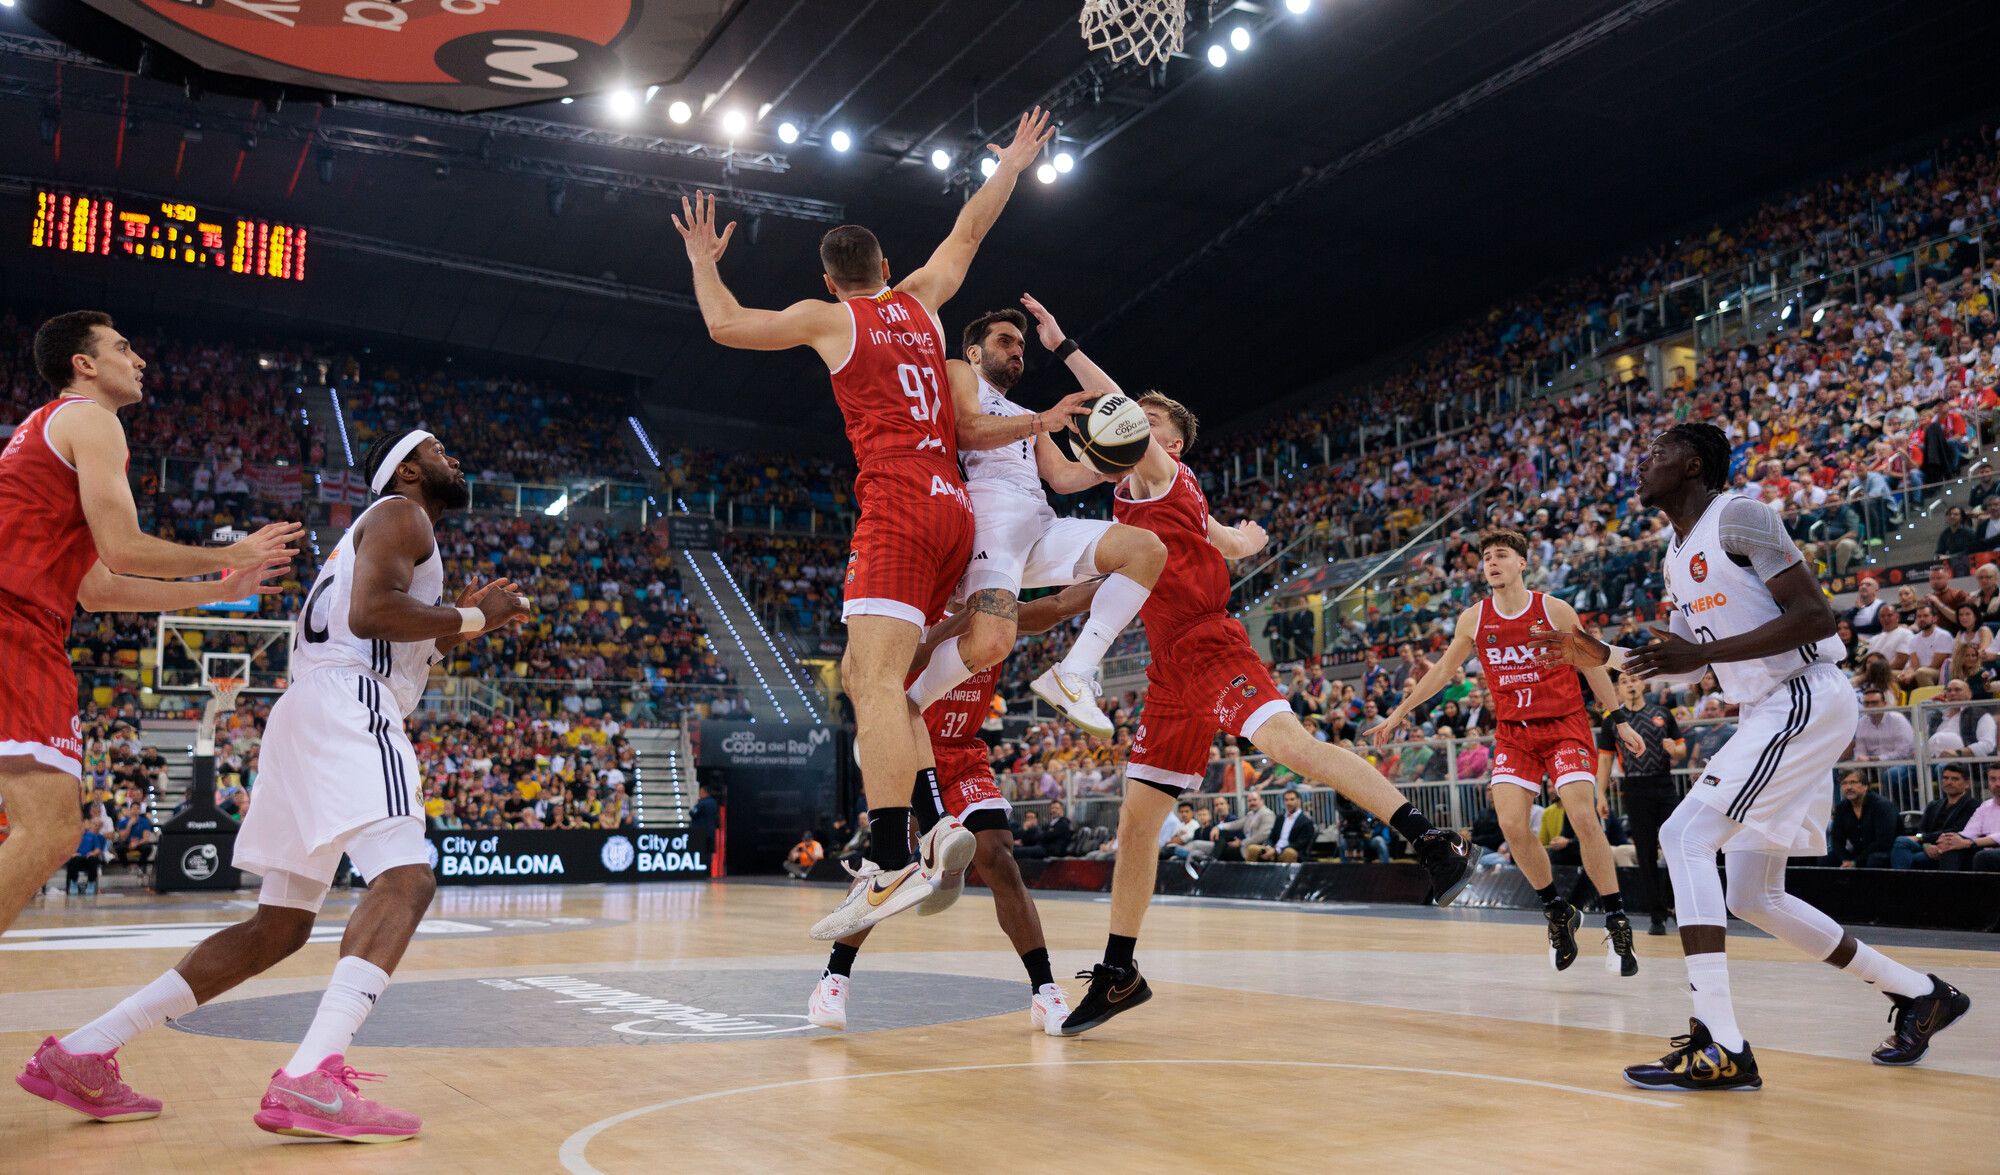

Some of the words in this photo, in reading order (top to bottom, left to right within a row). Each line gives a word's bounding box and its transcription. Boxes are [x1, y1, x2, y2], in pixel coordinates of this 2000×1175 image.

[161, 202, 197, 222] 4:50
[897, 363, 942, 425] 97
[1499, 671, 1541, 687] MANRESA
[1514, 687, 1532, 708] 17
[941, 711, 968, 738] 32
[721, 738, 766, 755] Copa
[767, 742, 787, 752] del
[788, 739, 816, 757] Rey
[442, 836, 478, 856] City
[480, 836, 499, 852] of
[637, 834, 670, 853] City
[672, 834, 689, 850] of
[442, 854, 564, 875] BADALONA
[637, 851, 707, 872] BADAL
